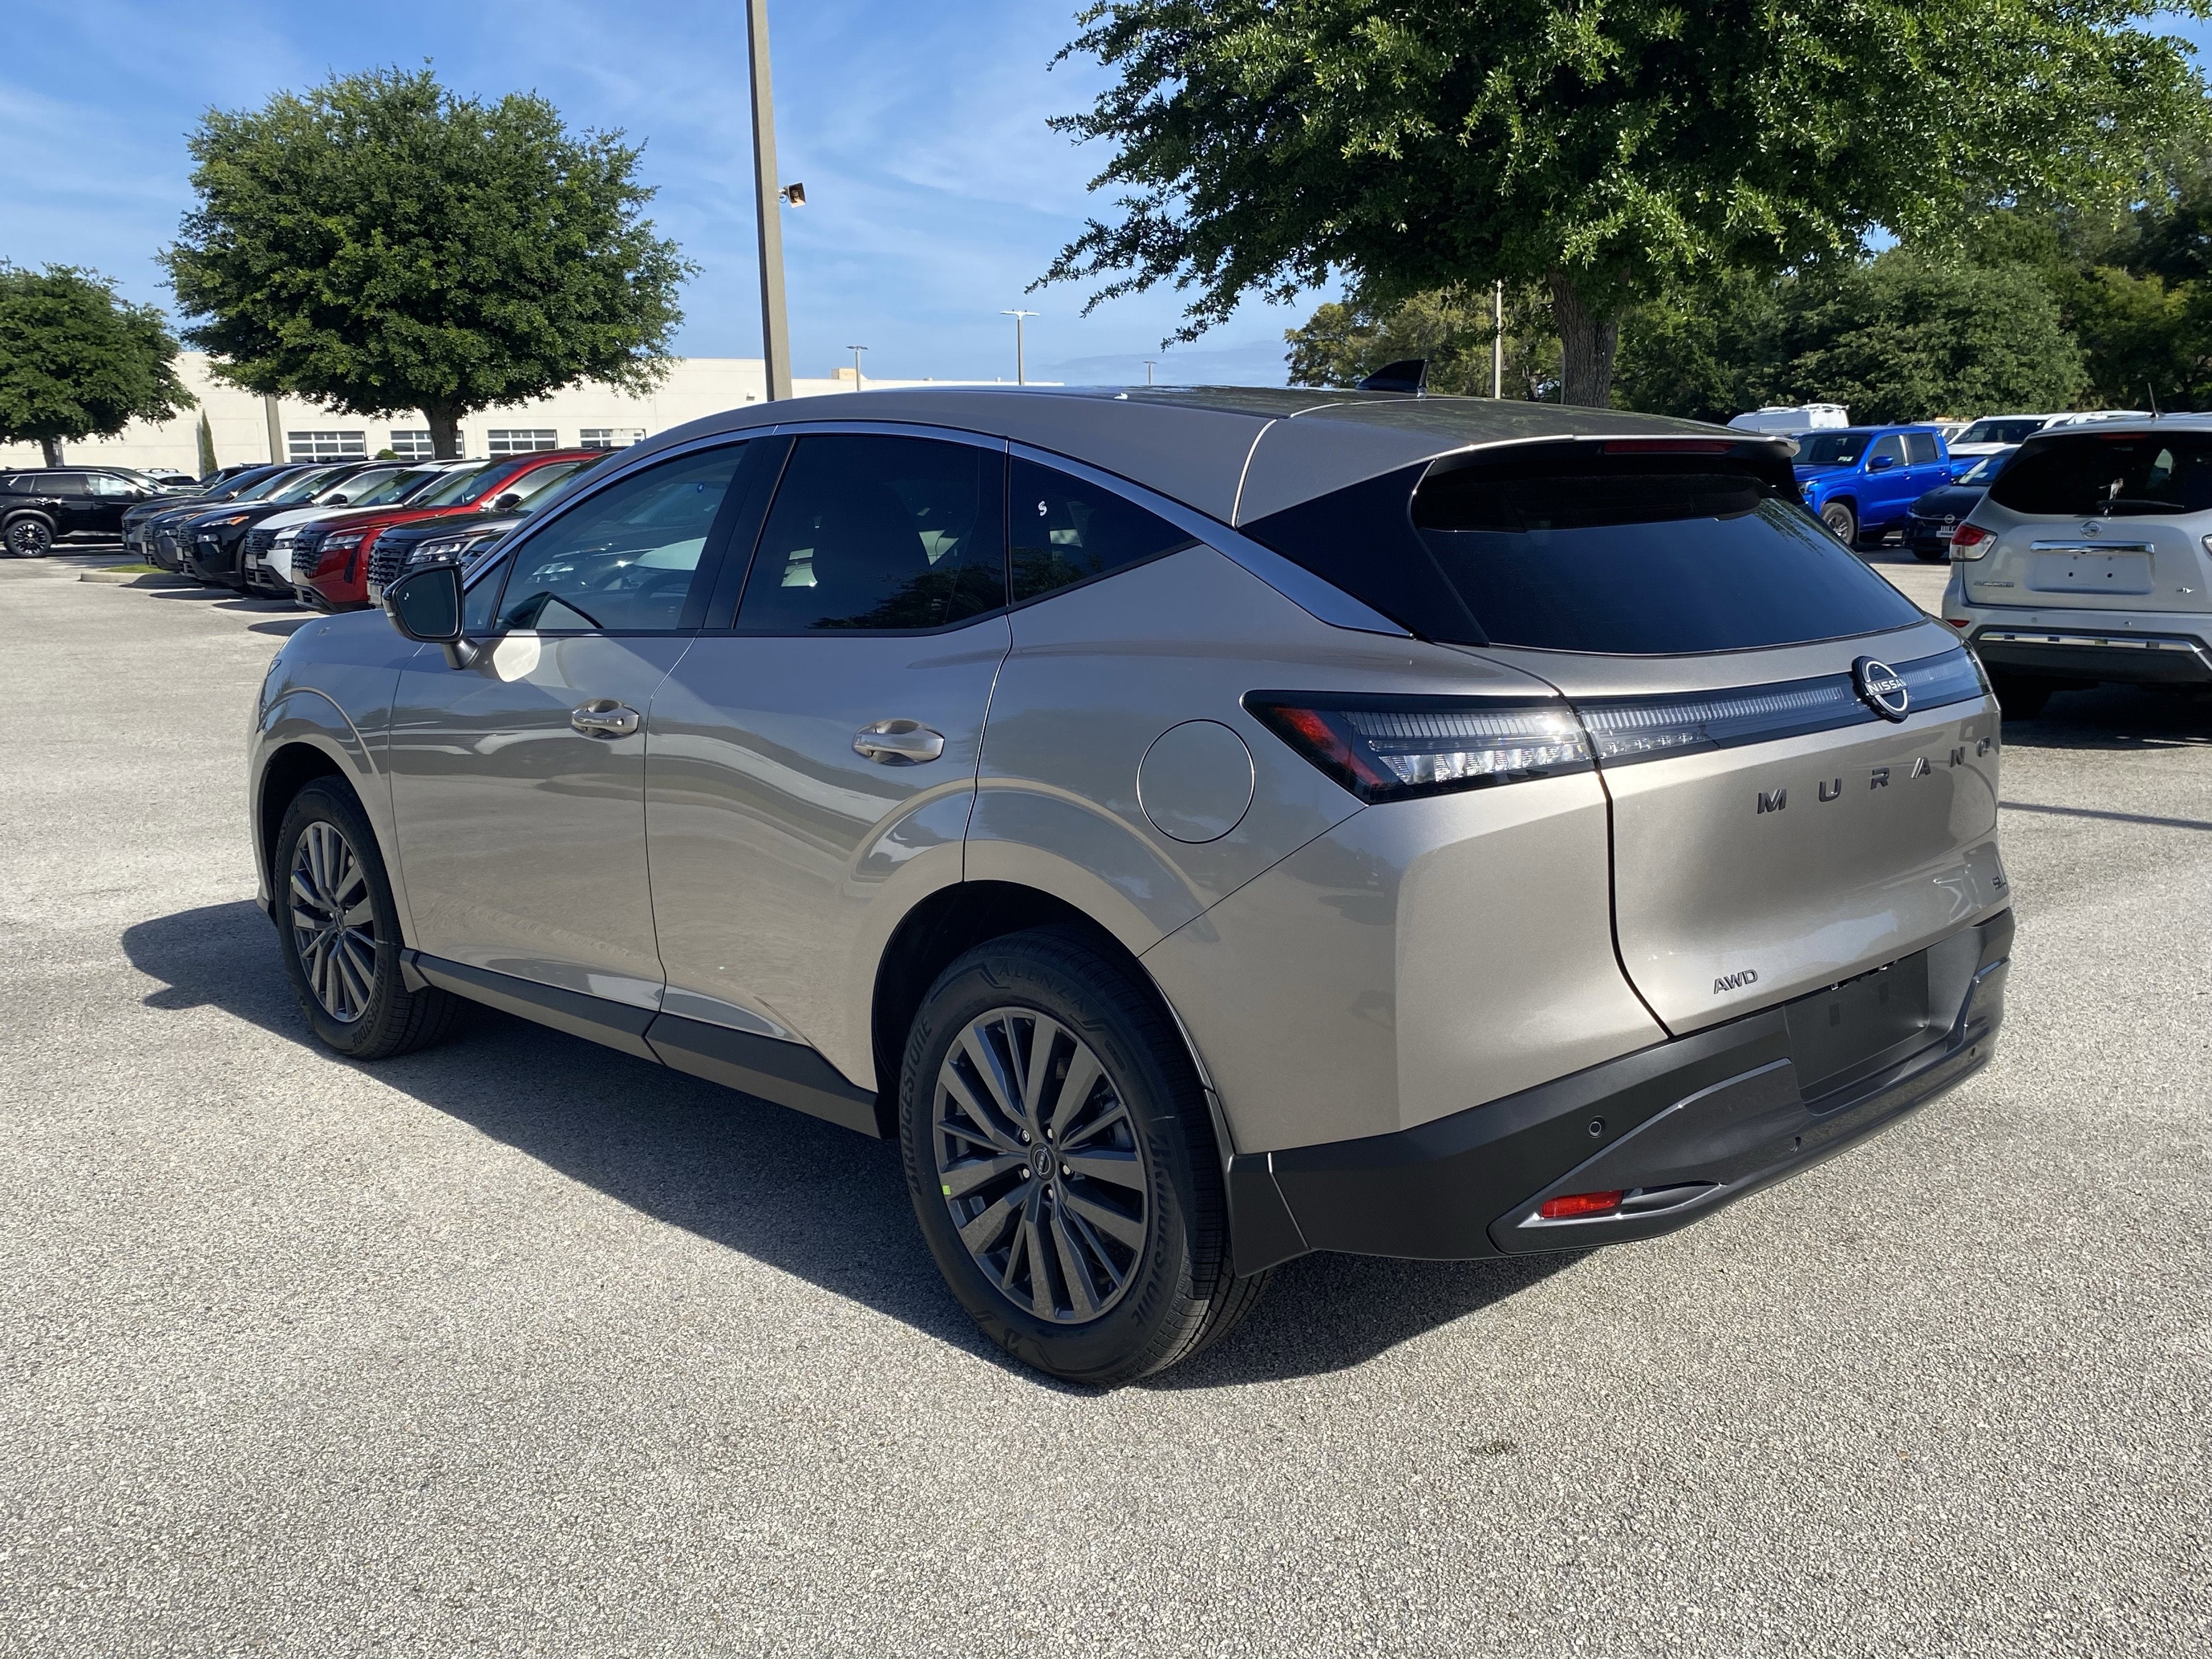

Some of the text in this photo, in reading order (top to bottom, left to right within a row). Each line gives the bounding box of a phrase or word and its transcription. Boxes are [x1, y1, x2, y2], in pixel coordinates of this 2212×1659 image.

[1866, 678, 1907, 693] NISSAN
[1757, 736, 1991, 815] MURANO
[998, 961, 1086, 1013] ALENZA
[1713, 969, 1758, 995] AWD
[901, 1016, 932, 1198] BRIDGESTONE
